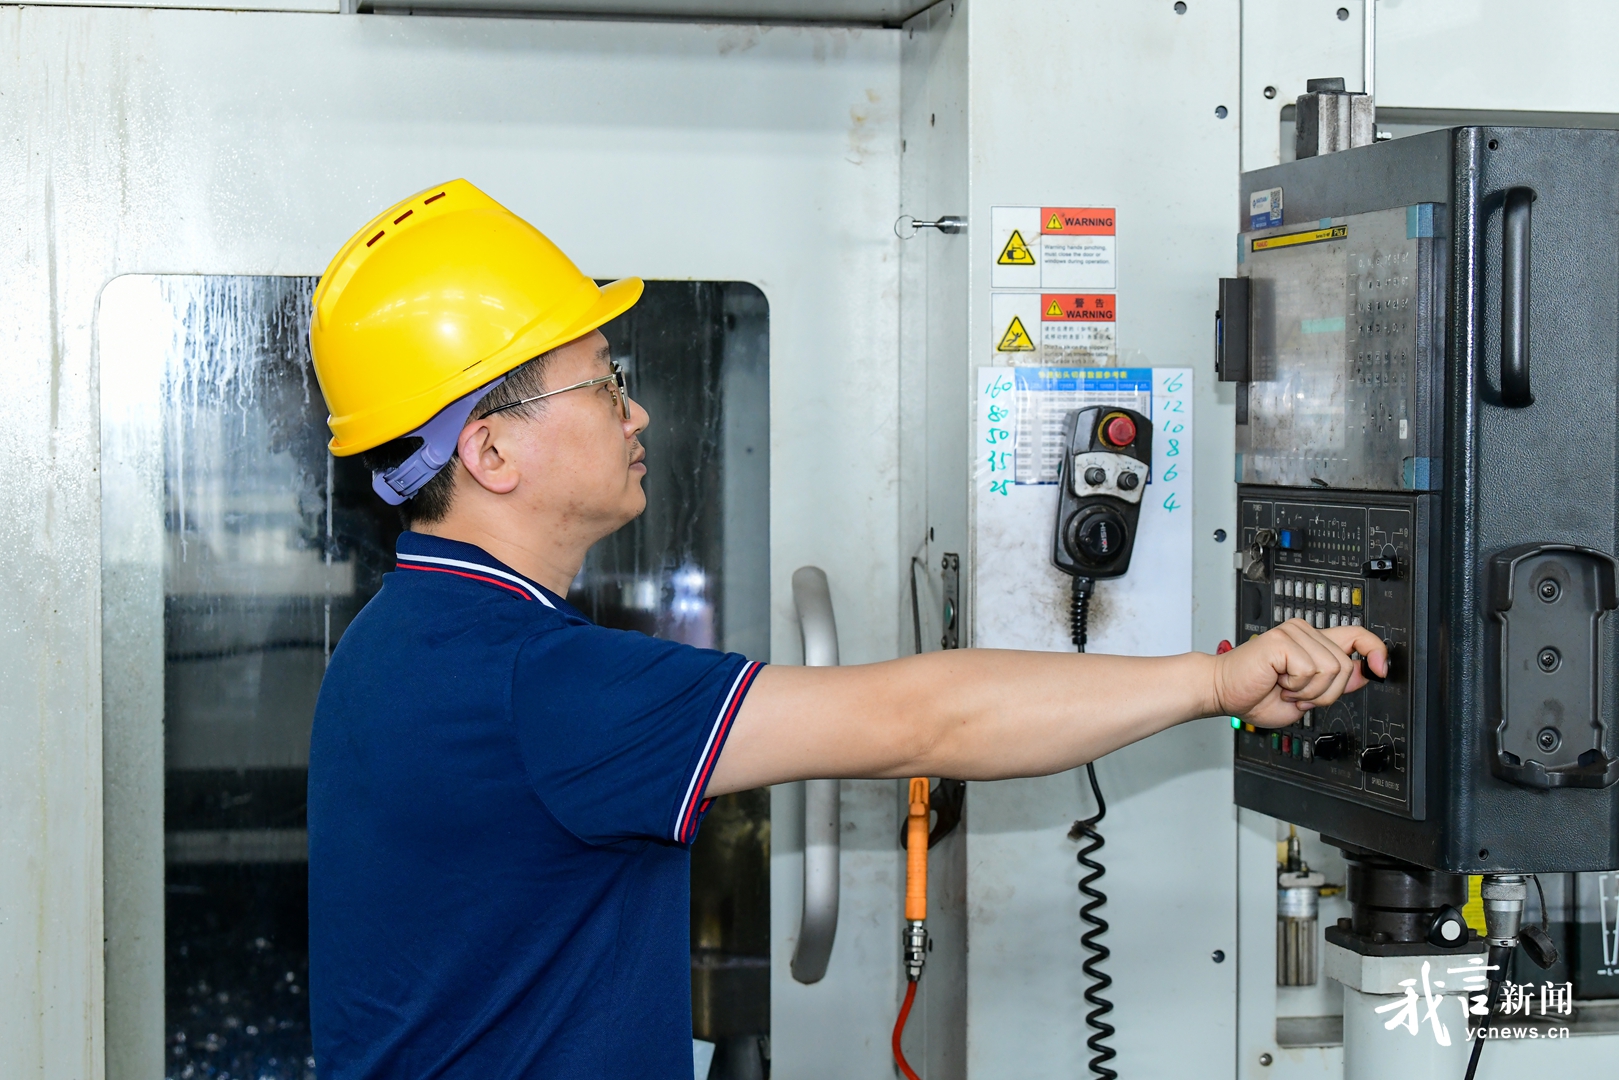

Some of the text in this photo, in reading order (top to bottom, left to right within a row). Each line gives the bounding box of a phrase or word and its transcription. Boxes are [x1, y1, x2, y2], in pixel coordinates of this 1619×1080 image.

[1064, 217, 1113, 227] WARNING
[1074, 298, 1104, 308] 警告
[1066, 310, 1113, 319] WARNING
[985, 375, 1013, 399] 160
[1163, 373, 1184, 393] 16
[987, 405, 1008, 423] 80
[1163, 400, 1184, 413] 12
[1163, 420, 1184, 433] 10
[986, 428, 1009, 444] 50
[1166, 438, 1180, 457] 8
[1163, 463, 1178, 482] 6
[989, 479, 1015, 496] 25
[1163, 492, 1181, 513] 4
